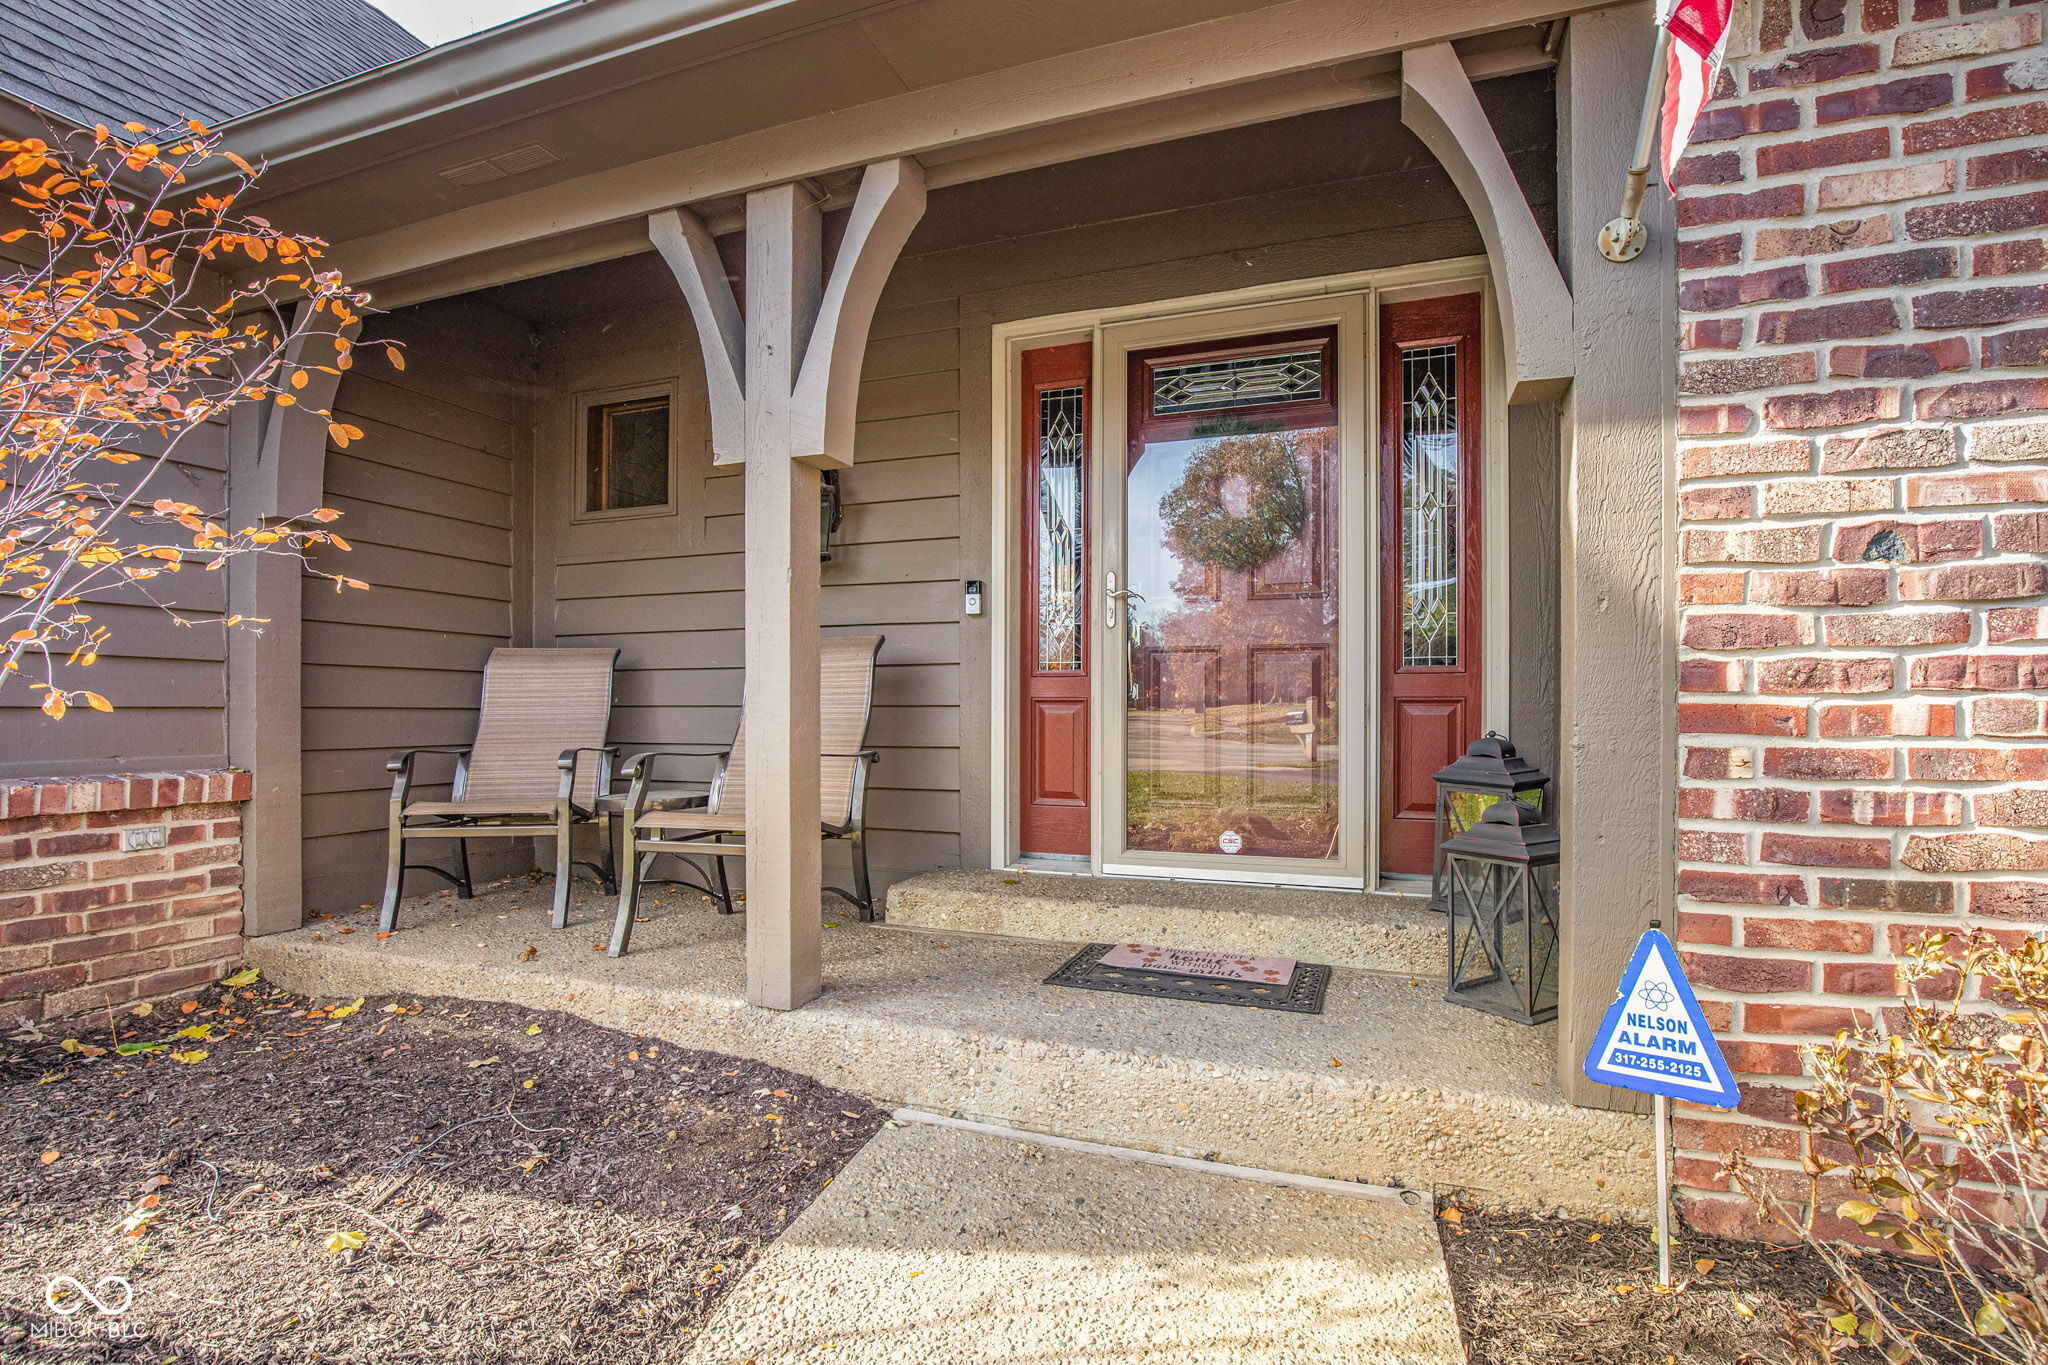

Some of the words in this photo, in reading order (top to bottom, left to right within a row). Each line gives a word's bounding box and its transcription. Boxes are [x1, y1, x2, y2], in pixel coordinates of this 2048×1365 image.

[1165, 948, 1201, 956] HOUSE
[1169, 953, 1230, 965] home
[1171, 960, 1223, 970] WITHOUT
[1626, 1012, 1688, 1035] NELSON
[1617, 1030, 1697, 1056] ALARM
[1614, 1052, 1702, 1078] 317-255-2125
